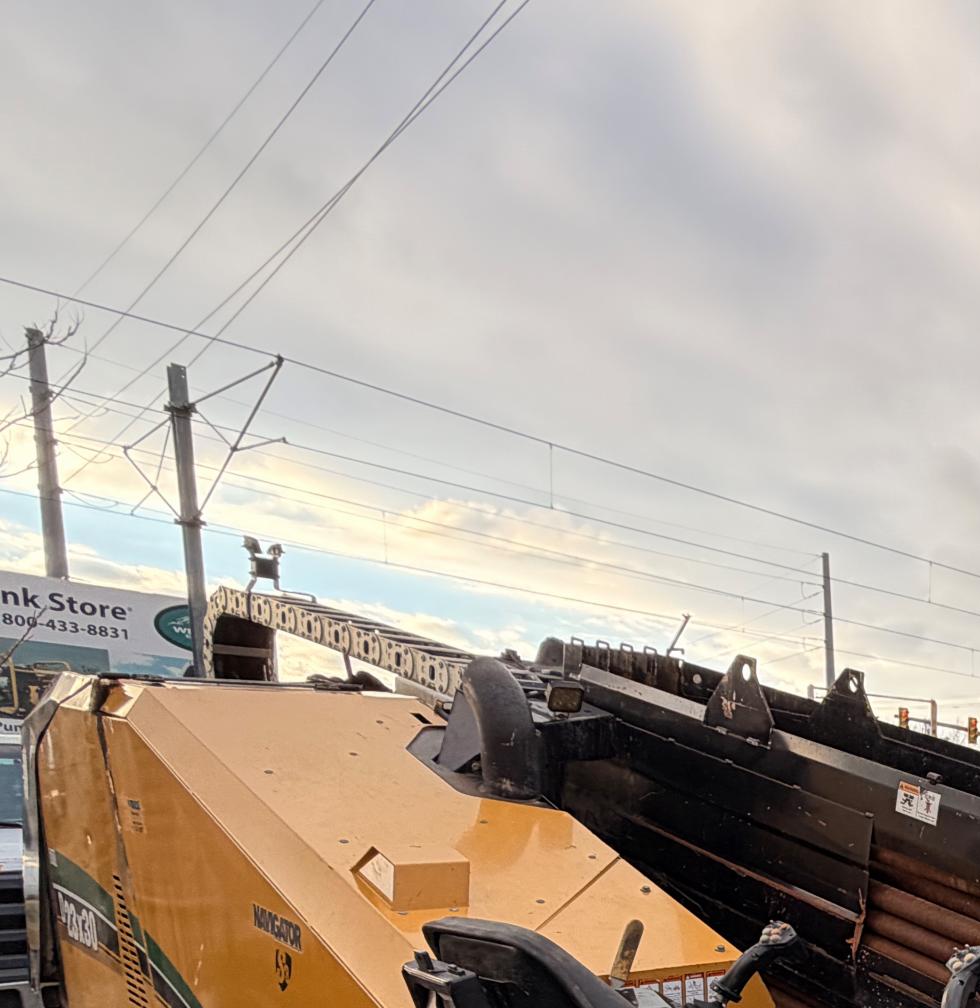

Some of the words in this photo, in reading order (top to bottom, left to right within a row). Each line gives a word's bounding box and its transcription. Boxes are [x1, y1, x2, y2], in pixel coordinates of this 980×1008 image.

[48, 592, 127, 620] Store
[2, 612, 128, 640] 800-433-8831
[253, 903, 302, 952] NAVIGATOR
